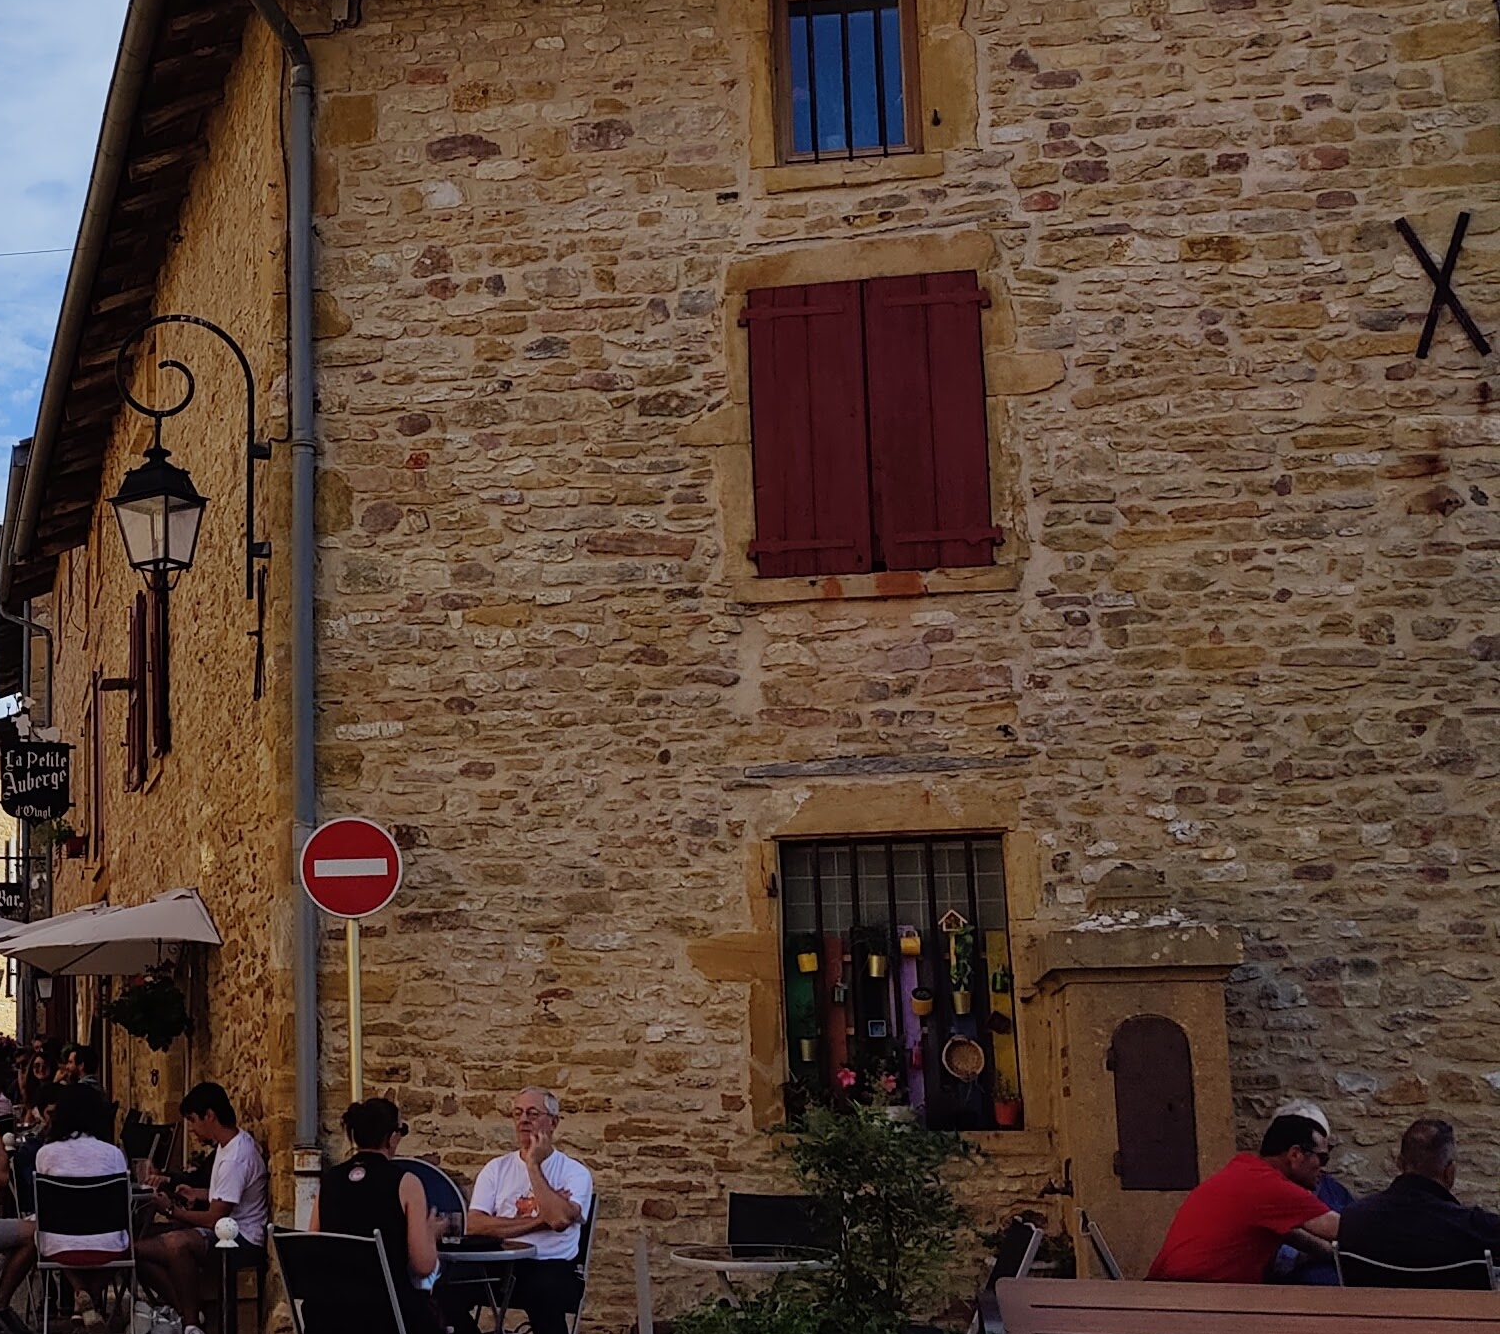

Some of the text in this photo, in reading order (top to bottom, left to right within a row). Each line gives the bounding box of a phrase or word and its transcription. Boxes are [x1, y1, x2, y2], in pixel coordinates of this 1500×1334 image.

[5, 750, 67, 771] La Petite
[2, 770, 67, 800] Auberge
